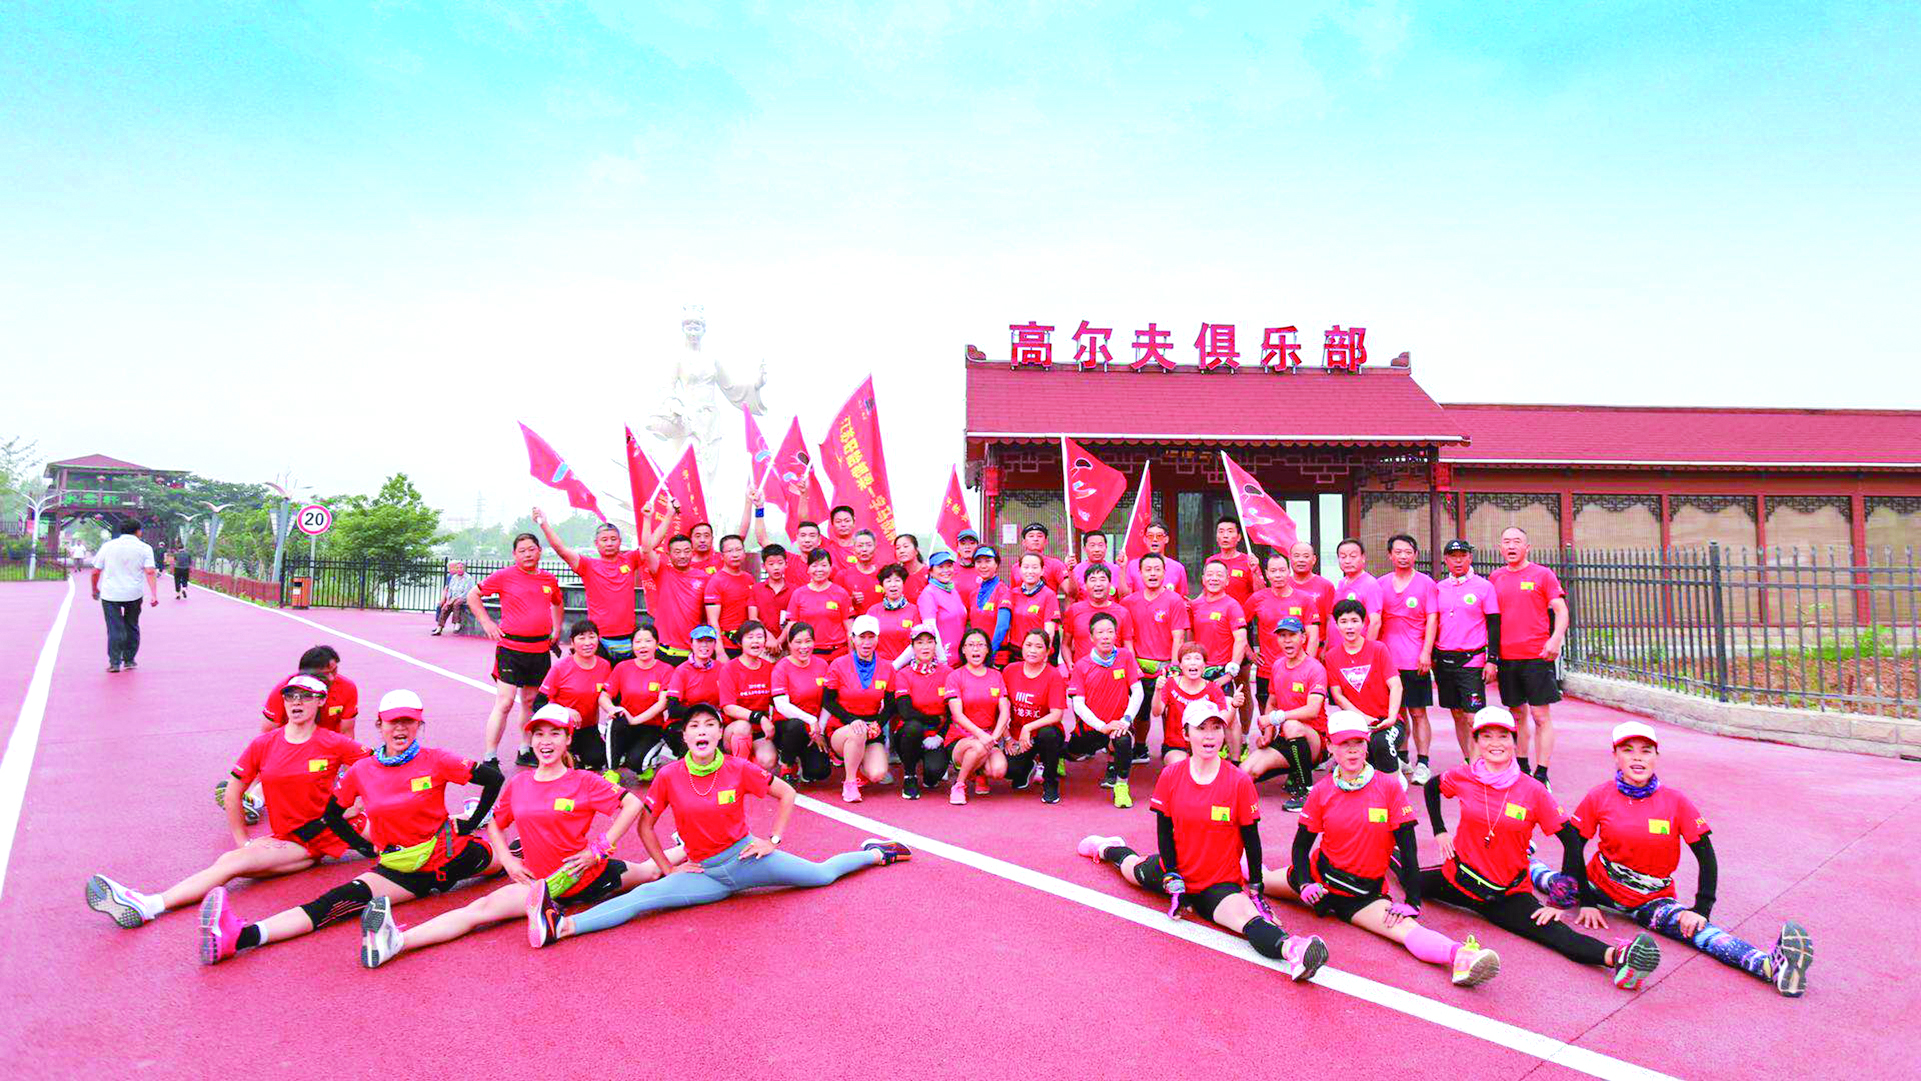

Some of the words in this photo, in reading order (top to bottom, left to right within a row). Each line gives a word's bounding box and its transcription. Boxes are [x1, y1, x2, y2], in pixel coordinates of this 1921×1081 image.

[1009, 321, 1367, 371] 高尔夫俱乐部
[304, 512, 324, 526] 20
